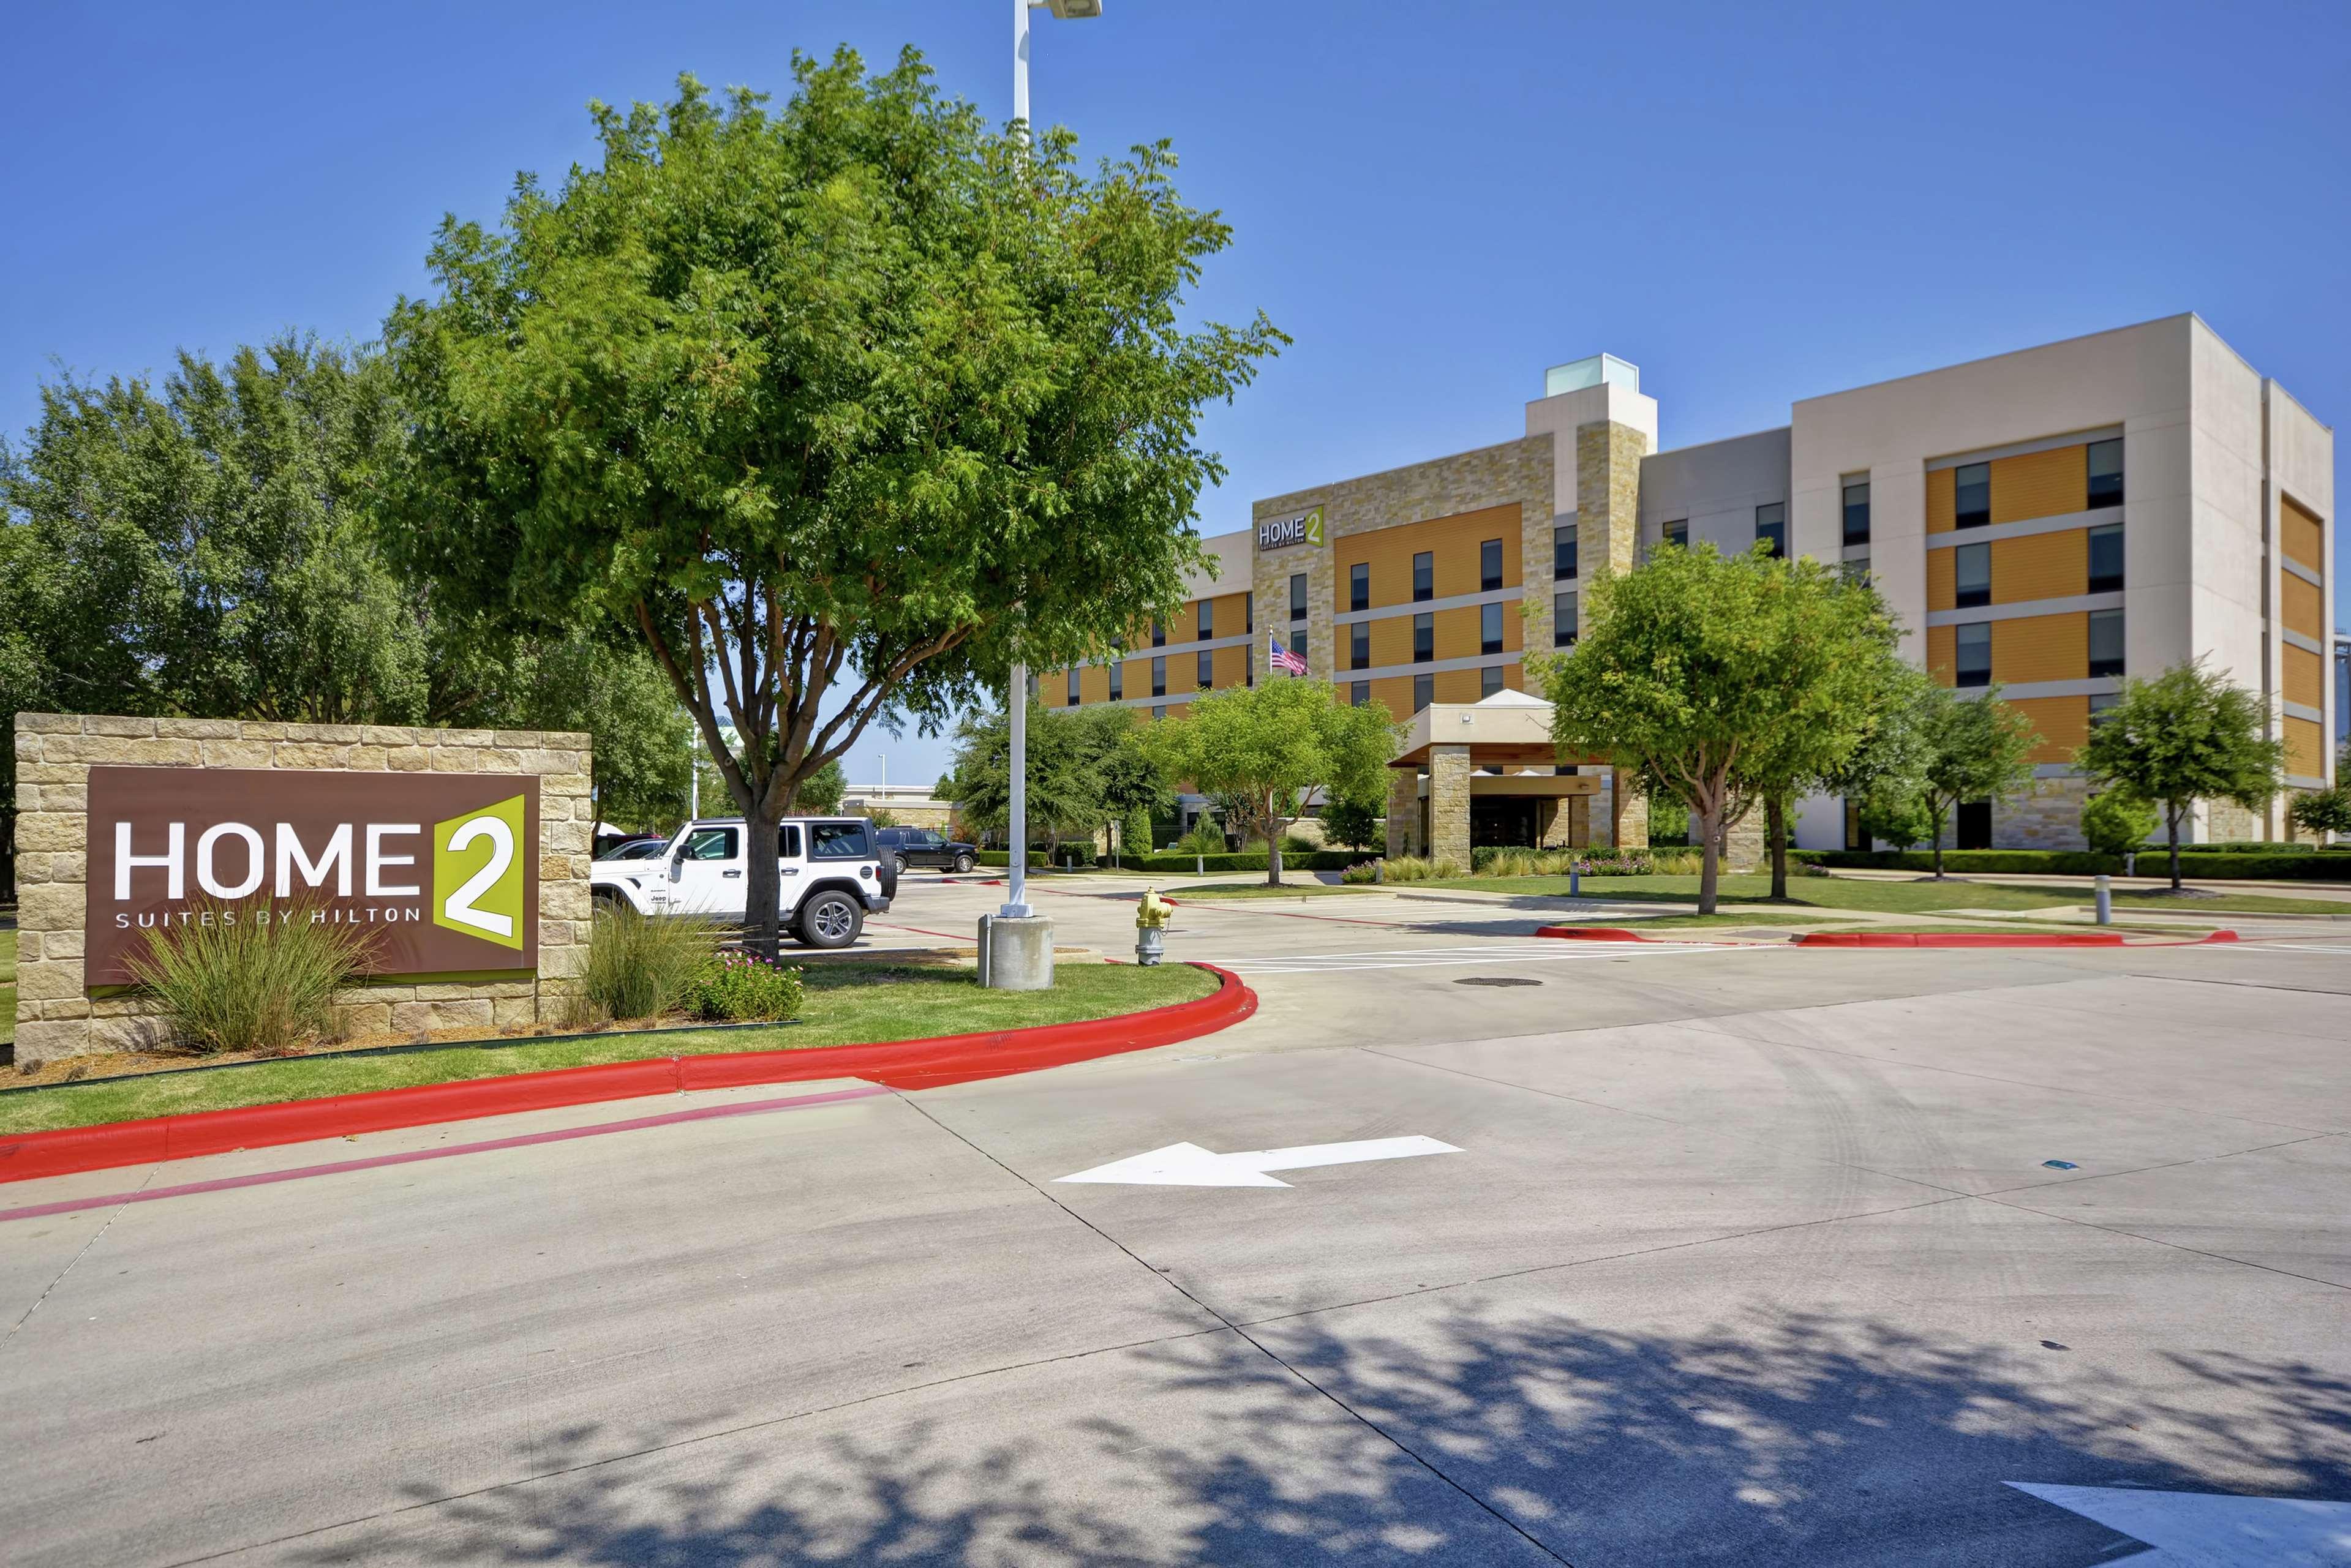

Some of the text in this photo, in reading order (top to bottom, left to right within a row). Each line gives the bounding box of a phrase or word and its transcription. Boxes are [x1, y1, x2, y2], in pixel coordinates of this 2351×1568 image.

[1259, 512, 1320, 544] HOME 2
[115, 815, 515, 938] HOME 2
[115, 907, 420, 928] SUITES BY HILTON
